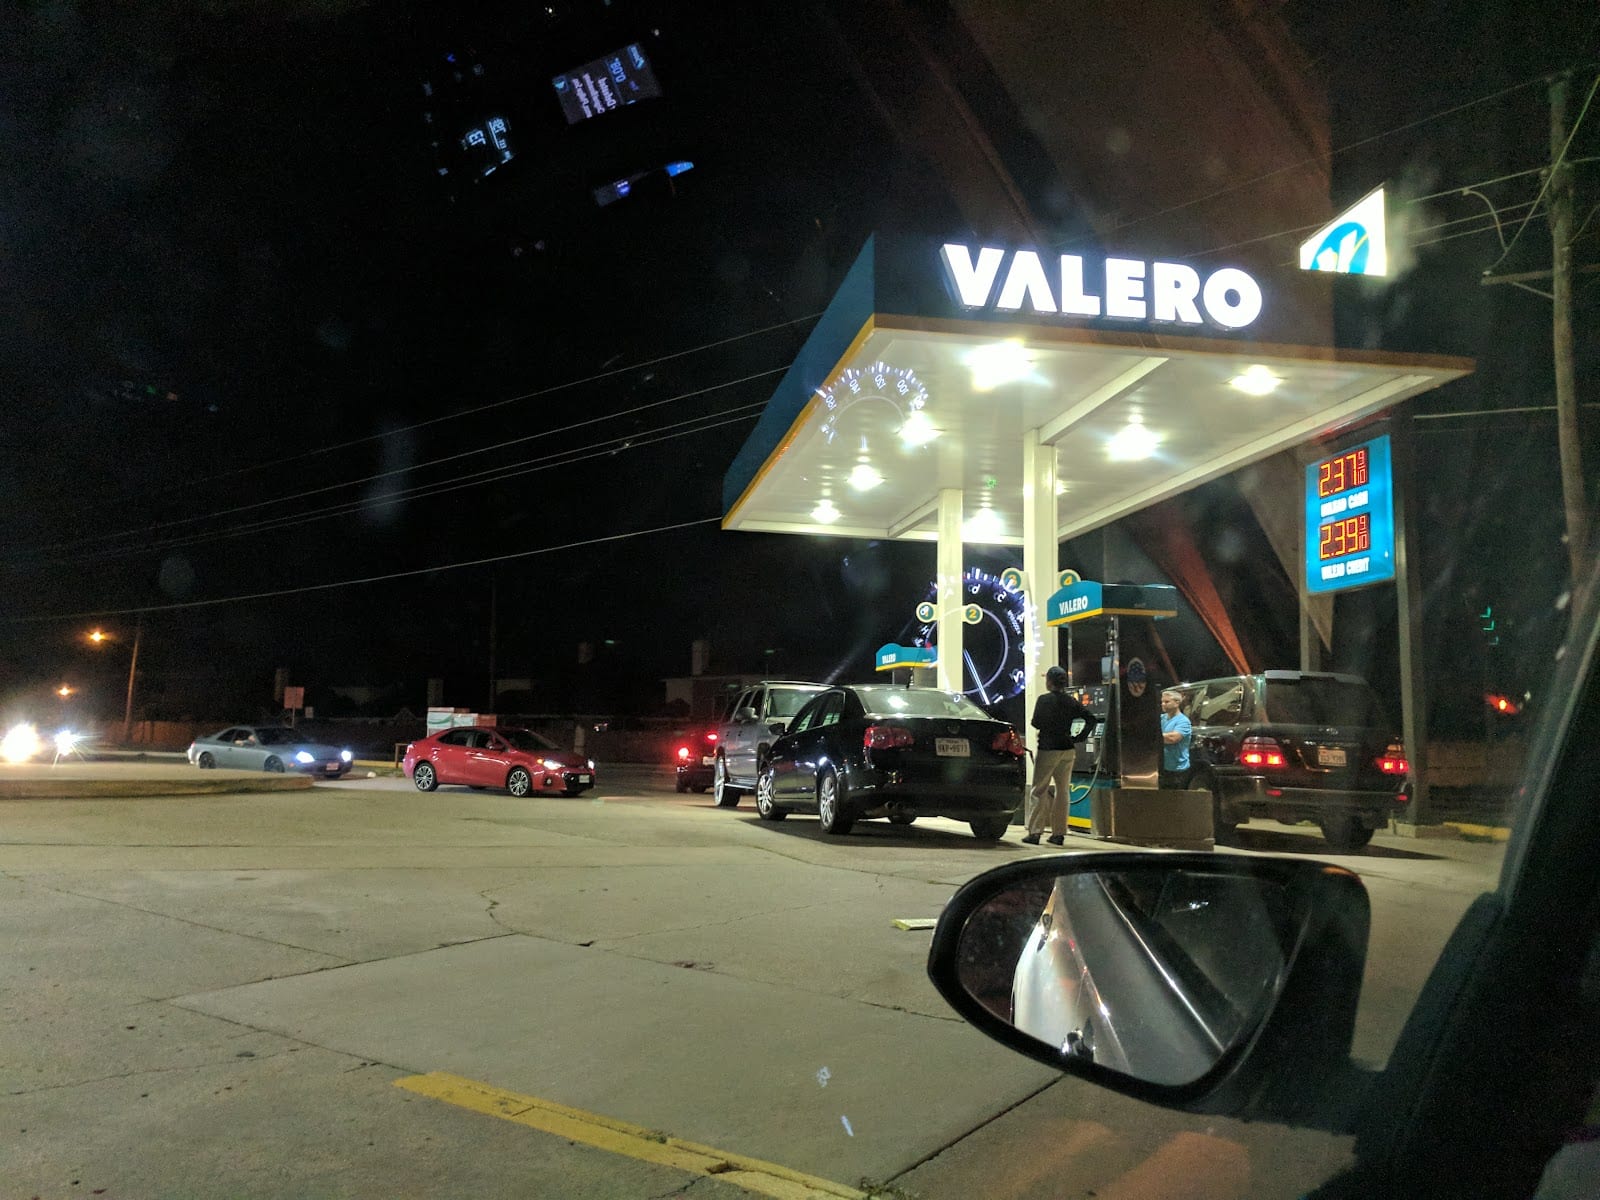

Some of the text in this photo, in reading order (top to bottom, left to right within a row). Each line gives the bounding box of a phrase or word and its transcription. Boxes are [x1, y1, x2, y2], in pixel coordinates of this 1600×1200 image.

[940, 243, 1263, 330] VALERO
[1319, 453, 1358, 498] 2.37
[1319, 517, 1359, 560] 2.39
[968, 608, 978, 619] 2
[1059, 595, 1088, 615] VALERO
